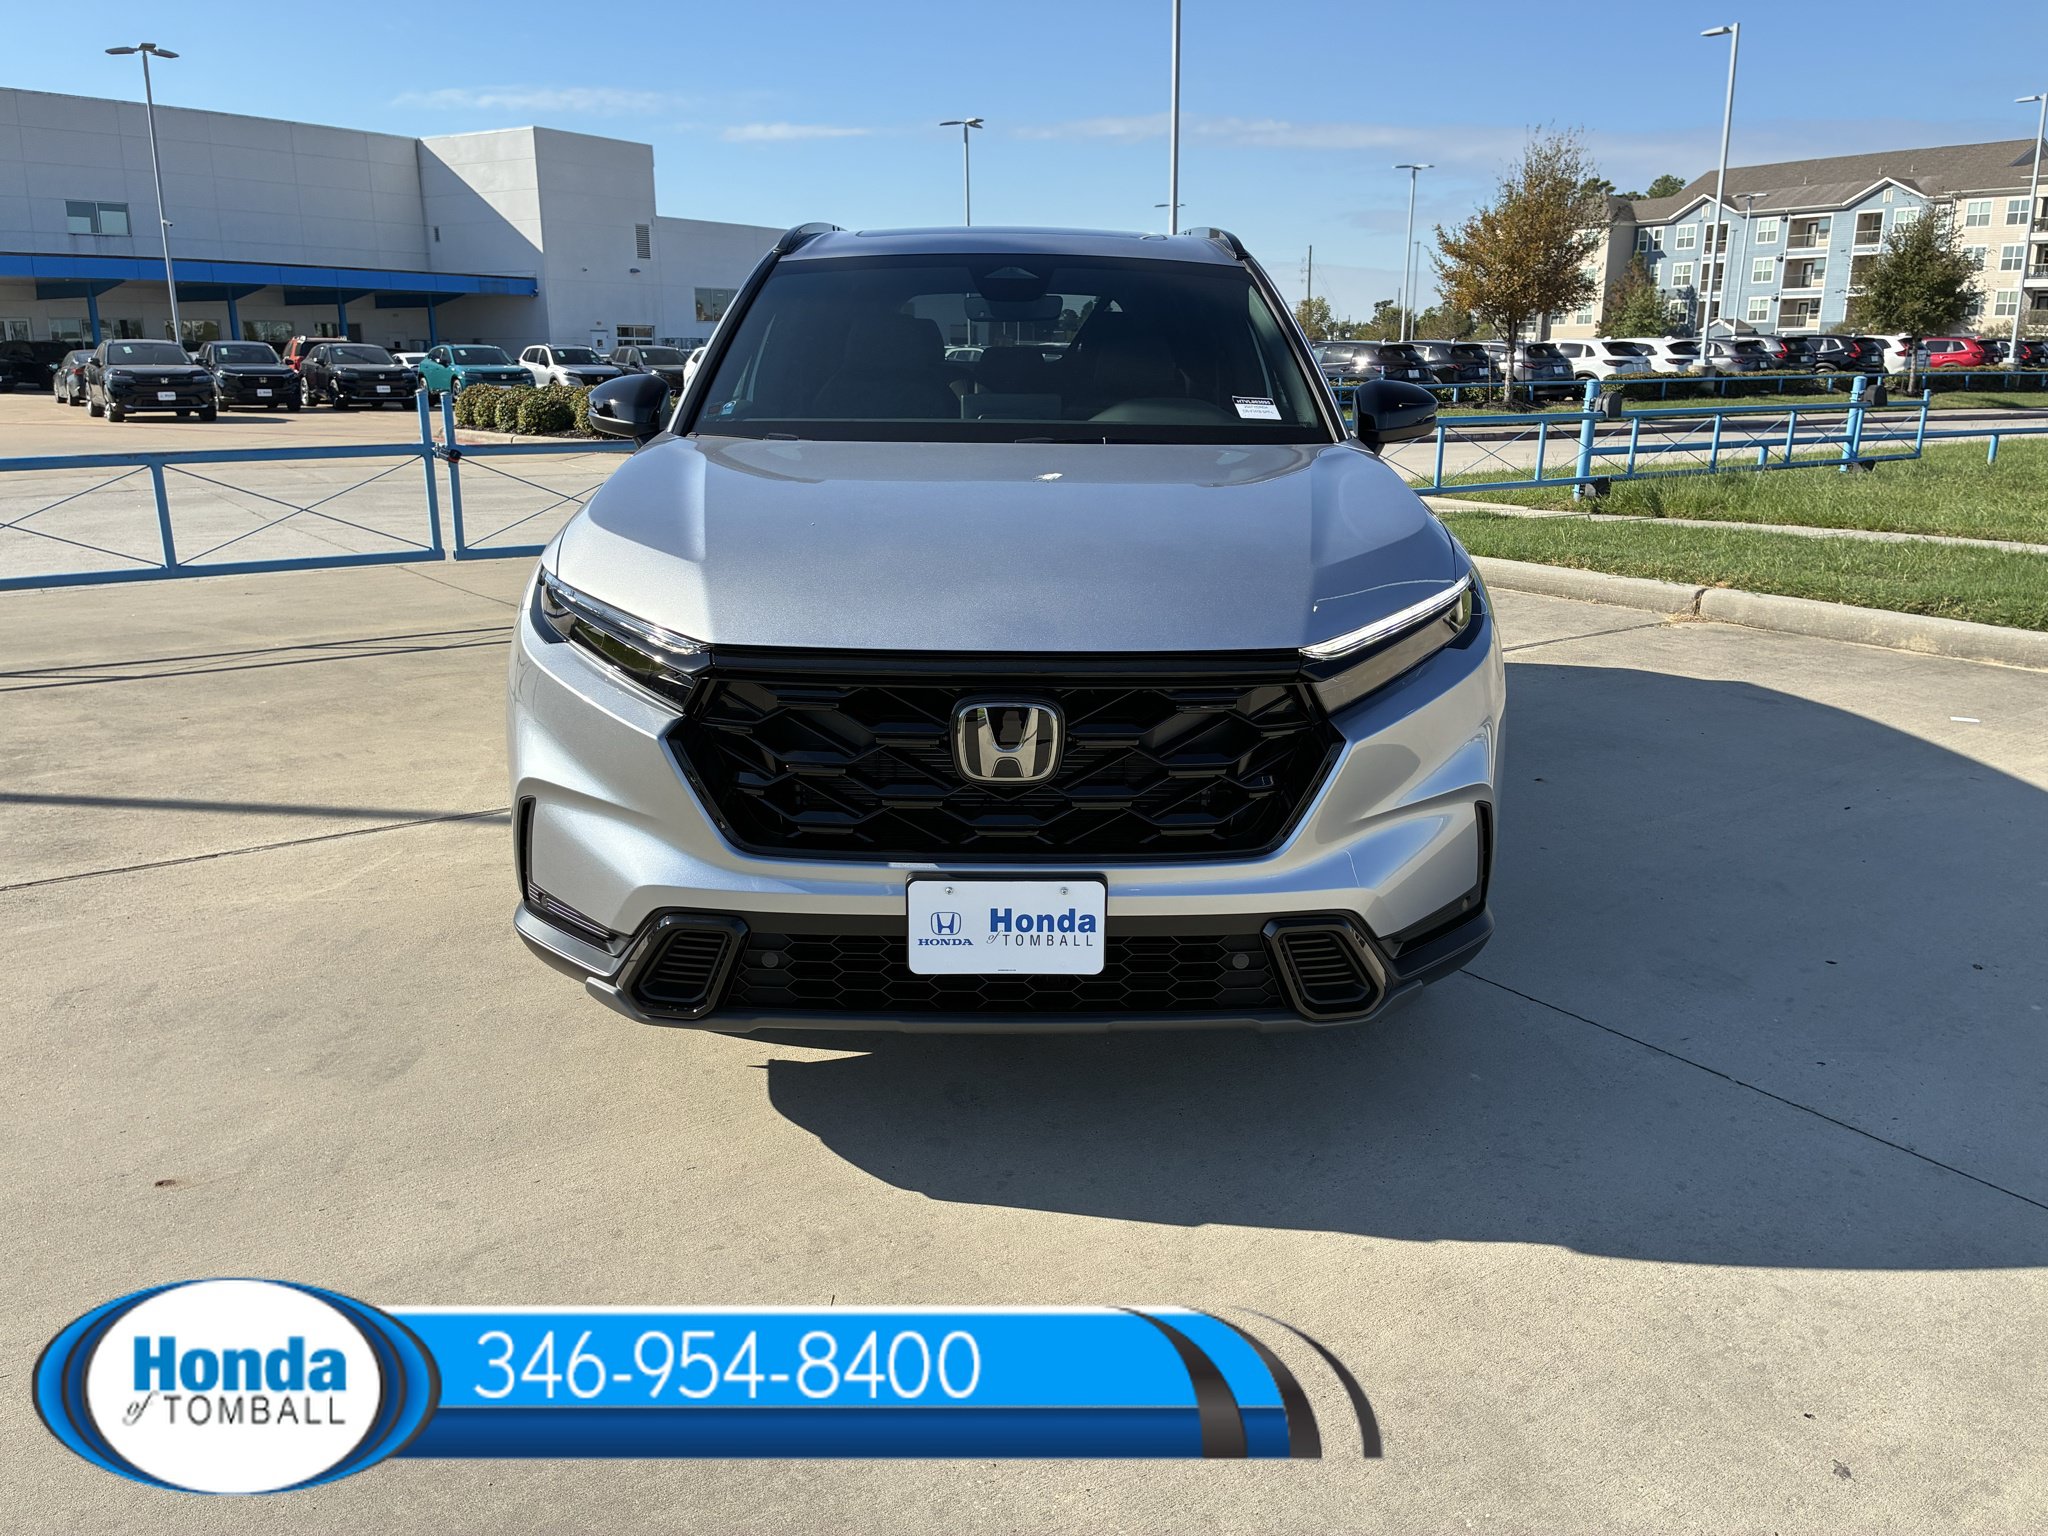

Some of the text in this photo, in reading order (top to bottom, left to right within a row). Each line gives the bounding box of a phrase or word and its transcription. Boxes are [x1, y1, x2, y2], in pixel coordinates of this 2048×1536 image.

[990, 908, 1096, 933] Honda
[918, 938, 974, 946] HONDA
[986, 930, 1093, 946] of TOMBALL
